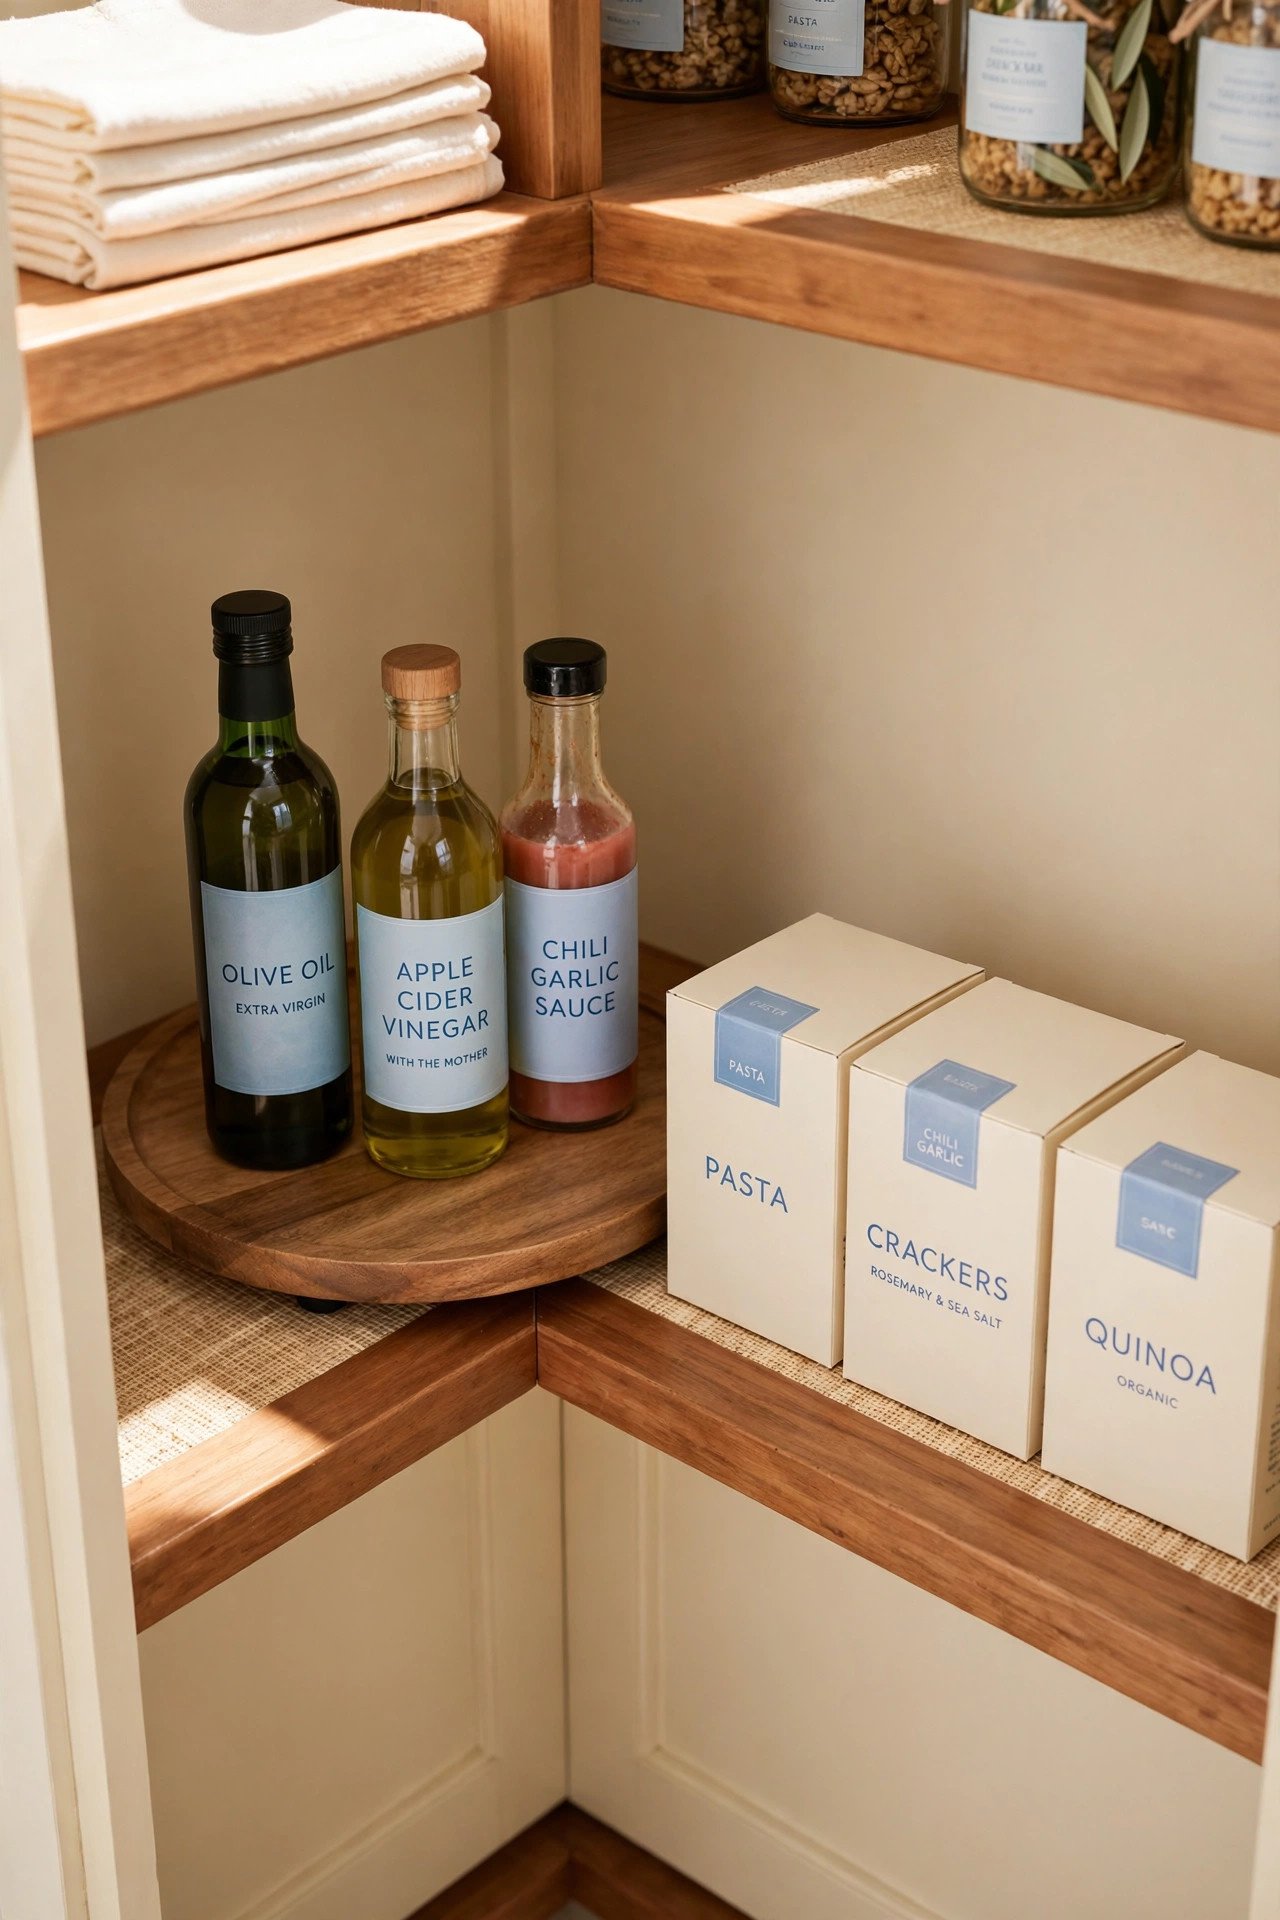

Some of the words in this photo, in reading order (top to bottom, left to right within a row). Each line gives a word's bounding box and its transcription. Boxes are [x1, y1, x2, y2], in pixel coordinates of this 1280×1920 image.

[788, 15, 818, 26] PASTA
[542, 936, 607, 960] CHILI
[222, 963, 293, 986] OLIVE
[301, 953, 335, 980] OIL
[397, 956, 473, 982] APPLE
[531, 961, 619, 989] GARLIC
[236, 1002, 279, 1015] EXTRA
[282, 992, 326, 1014] VIRGIN
[397, 986, 473, 1011] CIDER
[535, 991, 615, 1018] SAUCE
[382, 1009, 489, 1040] VINEGAR
[386, 1053, 415, 1068] WITH
[418, 1058, 440, 1069] THE
[444, 1047, 488, 1068] MOTHER
[729, 1059, 765, 1085] PASTA
[924, 1128, 958, 1150] CHILI
[917, 1140, 964, 1167] GARLIC
[705, 1155, 788, 1214] PASTA
[867, 1223, 1008, 1301] CRACKERS
[870, 1265, 932, 1301] ROSEMARY
[935, 1294, 944, 1306] &
[948, 1299, 970, 1317] SEA
[973, 1310, 1003, 1329] SALT
[1085, 1317, 1217, 1395] QUINOA
[1116, 1374, 1179, 1410] ORGANIC
